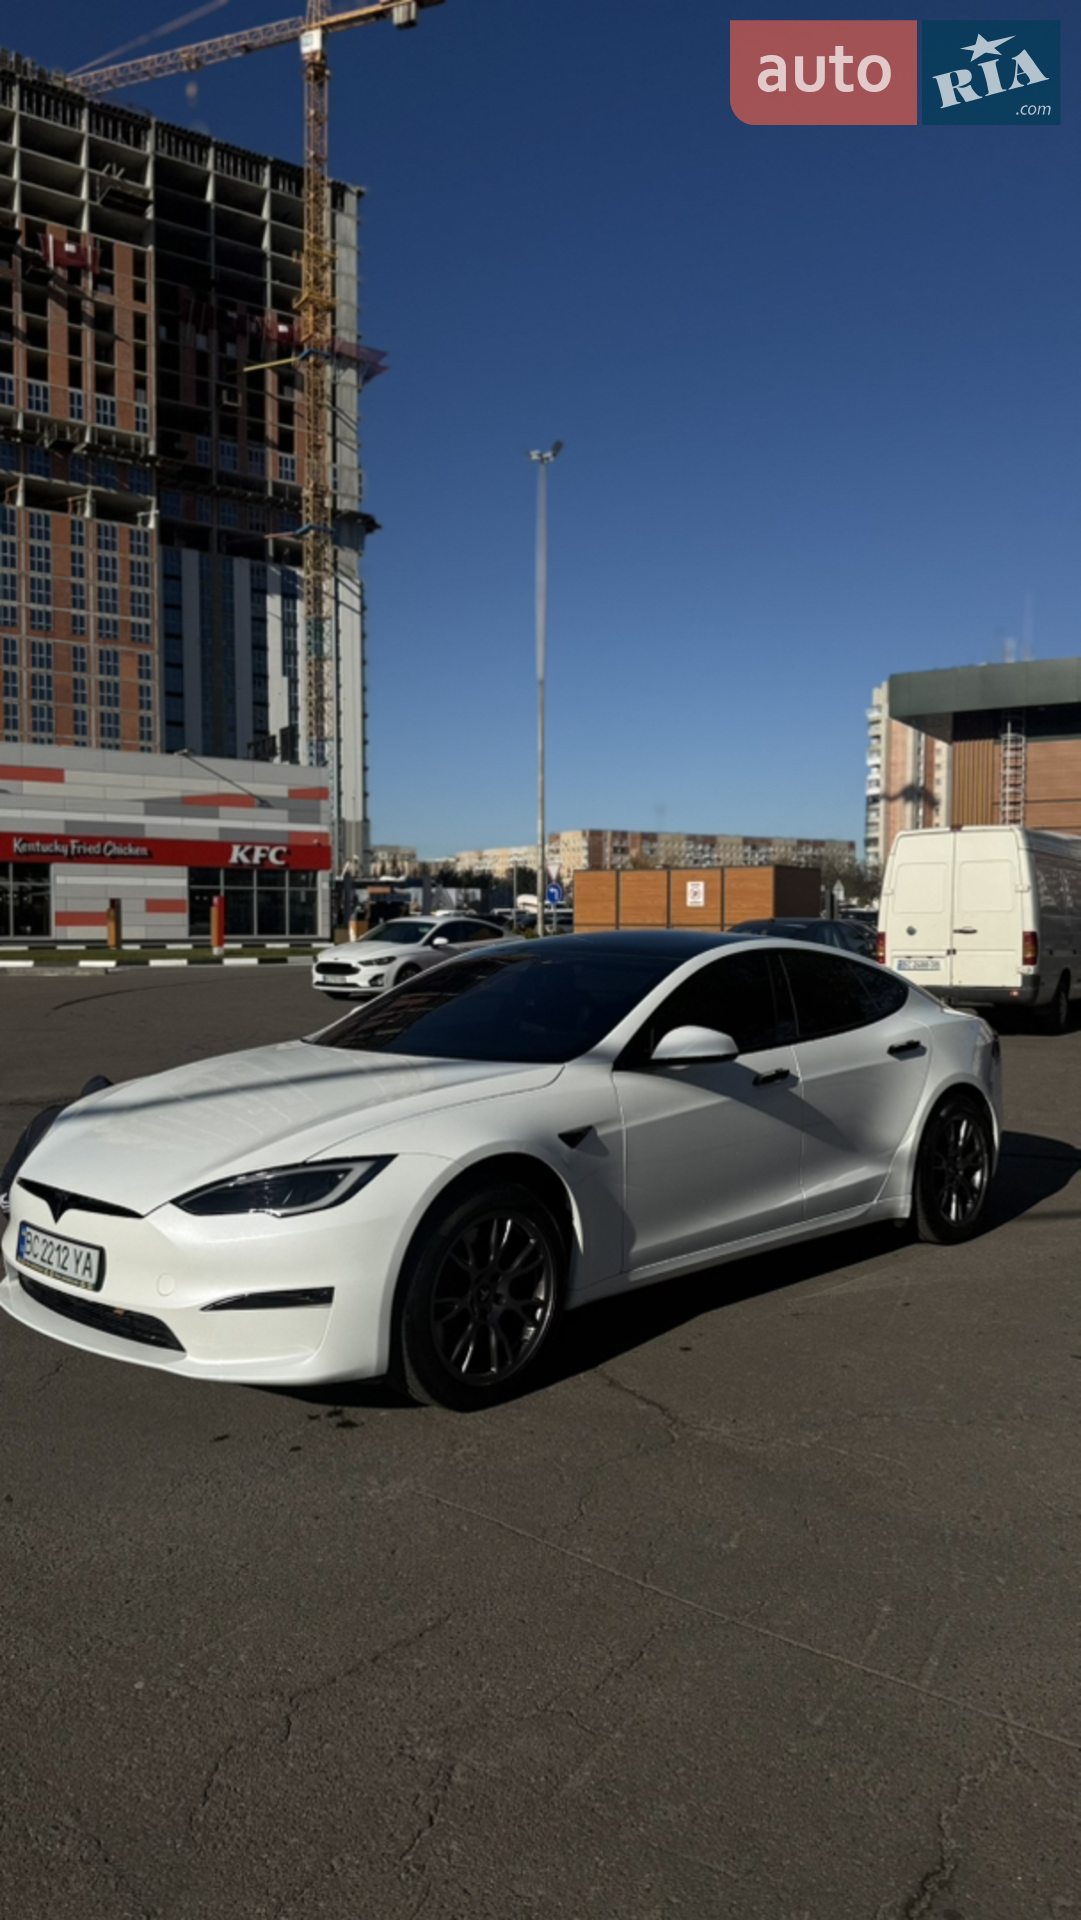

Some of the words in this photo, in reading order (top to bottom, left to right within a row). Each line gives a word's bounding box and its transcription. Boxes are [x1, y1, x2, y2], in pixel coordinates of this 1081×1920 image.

[13, 837, 68, 856] Kentucky
[70, 839, 102, 855] Fried
[103, 840, 148, 856] Chicken
[229, 844, 287, 865] KFC
[25, 1231, 39, 1258] BC
[40, 1239, 69, 1271] 2212
[73, 1248, 93, 1279] YA
